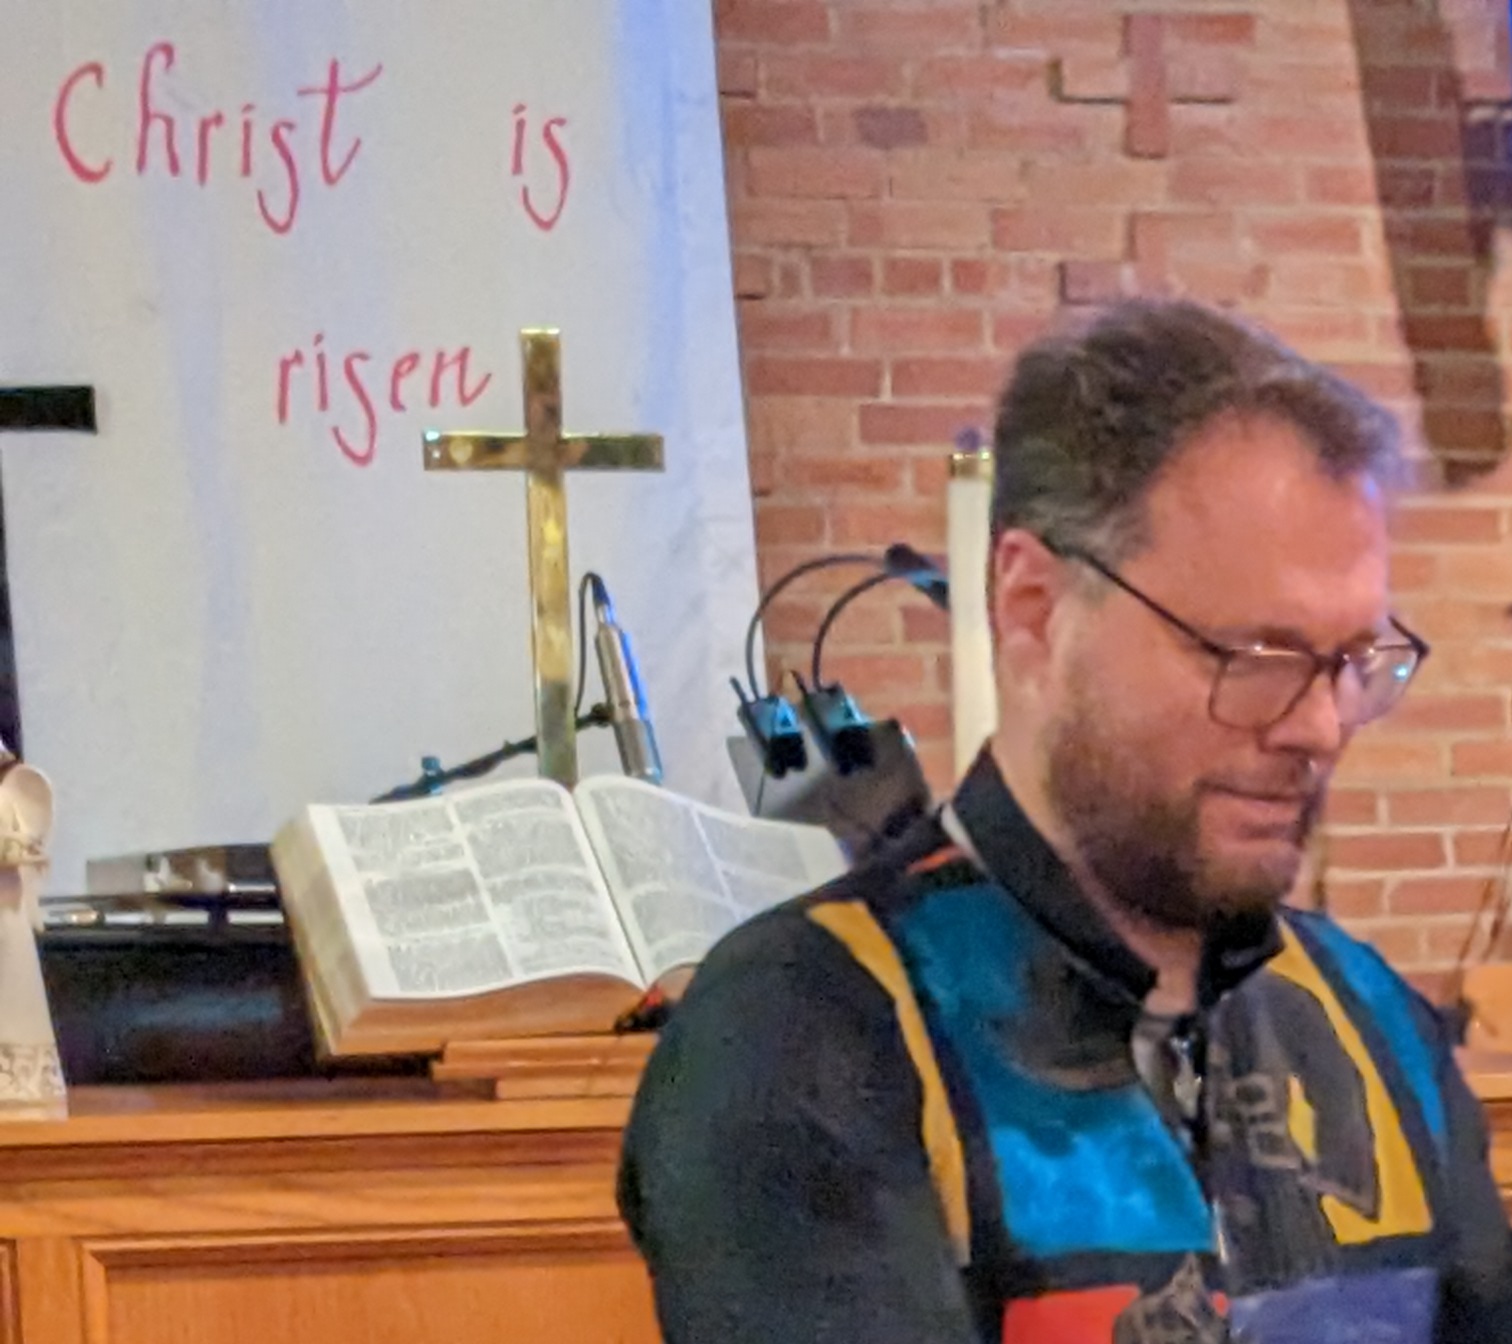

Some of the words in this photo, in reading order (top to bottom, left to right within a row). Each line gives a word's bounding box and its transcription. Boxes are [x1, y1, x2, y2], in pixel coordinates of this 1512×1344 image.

[50, 41, 383, 236] Christ
[510, 103, 571, 232] is
[275, 333, 493, 467] risen
